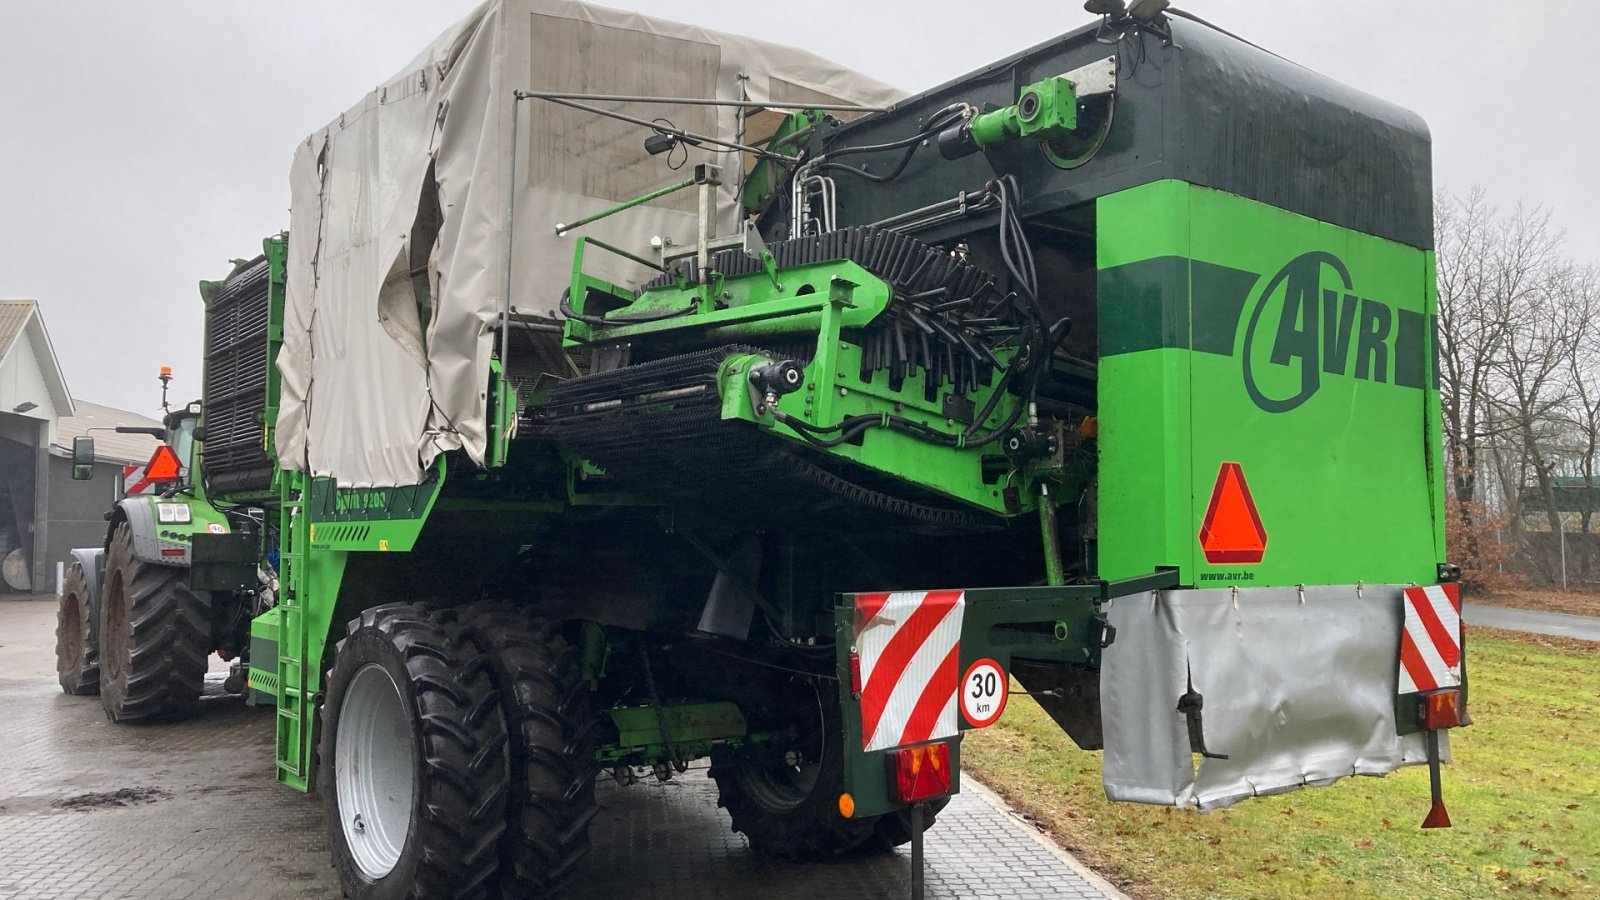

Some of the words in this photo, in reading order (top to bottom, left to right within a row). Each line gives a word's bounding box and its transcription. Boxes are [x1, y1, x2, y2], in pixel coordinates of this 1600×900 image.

[1243, 251, 1392, 413] AVR
[1200, 571, 1254, 580] www.avr.be
[971, 672, 996, 698] 30
[976, 703, 990, 713] km
